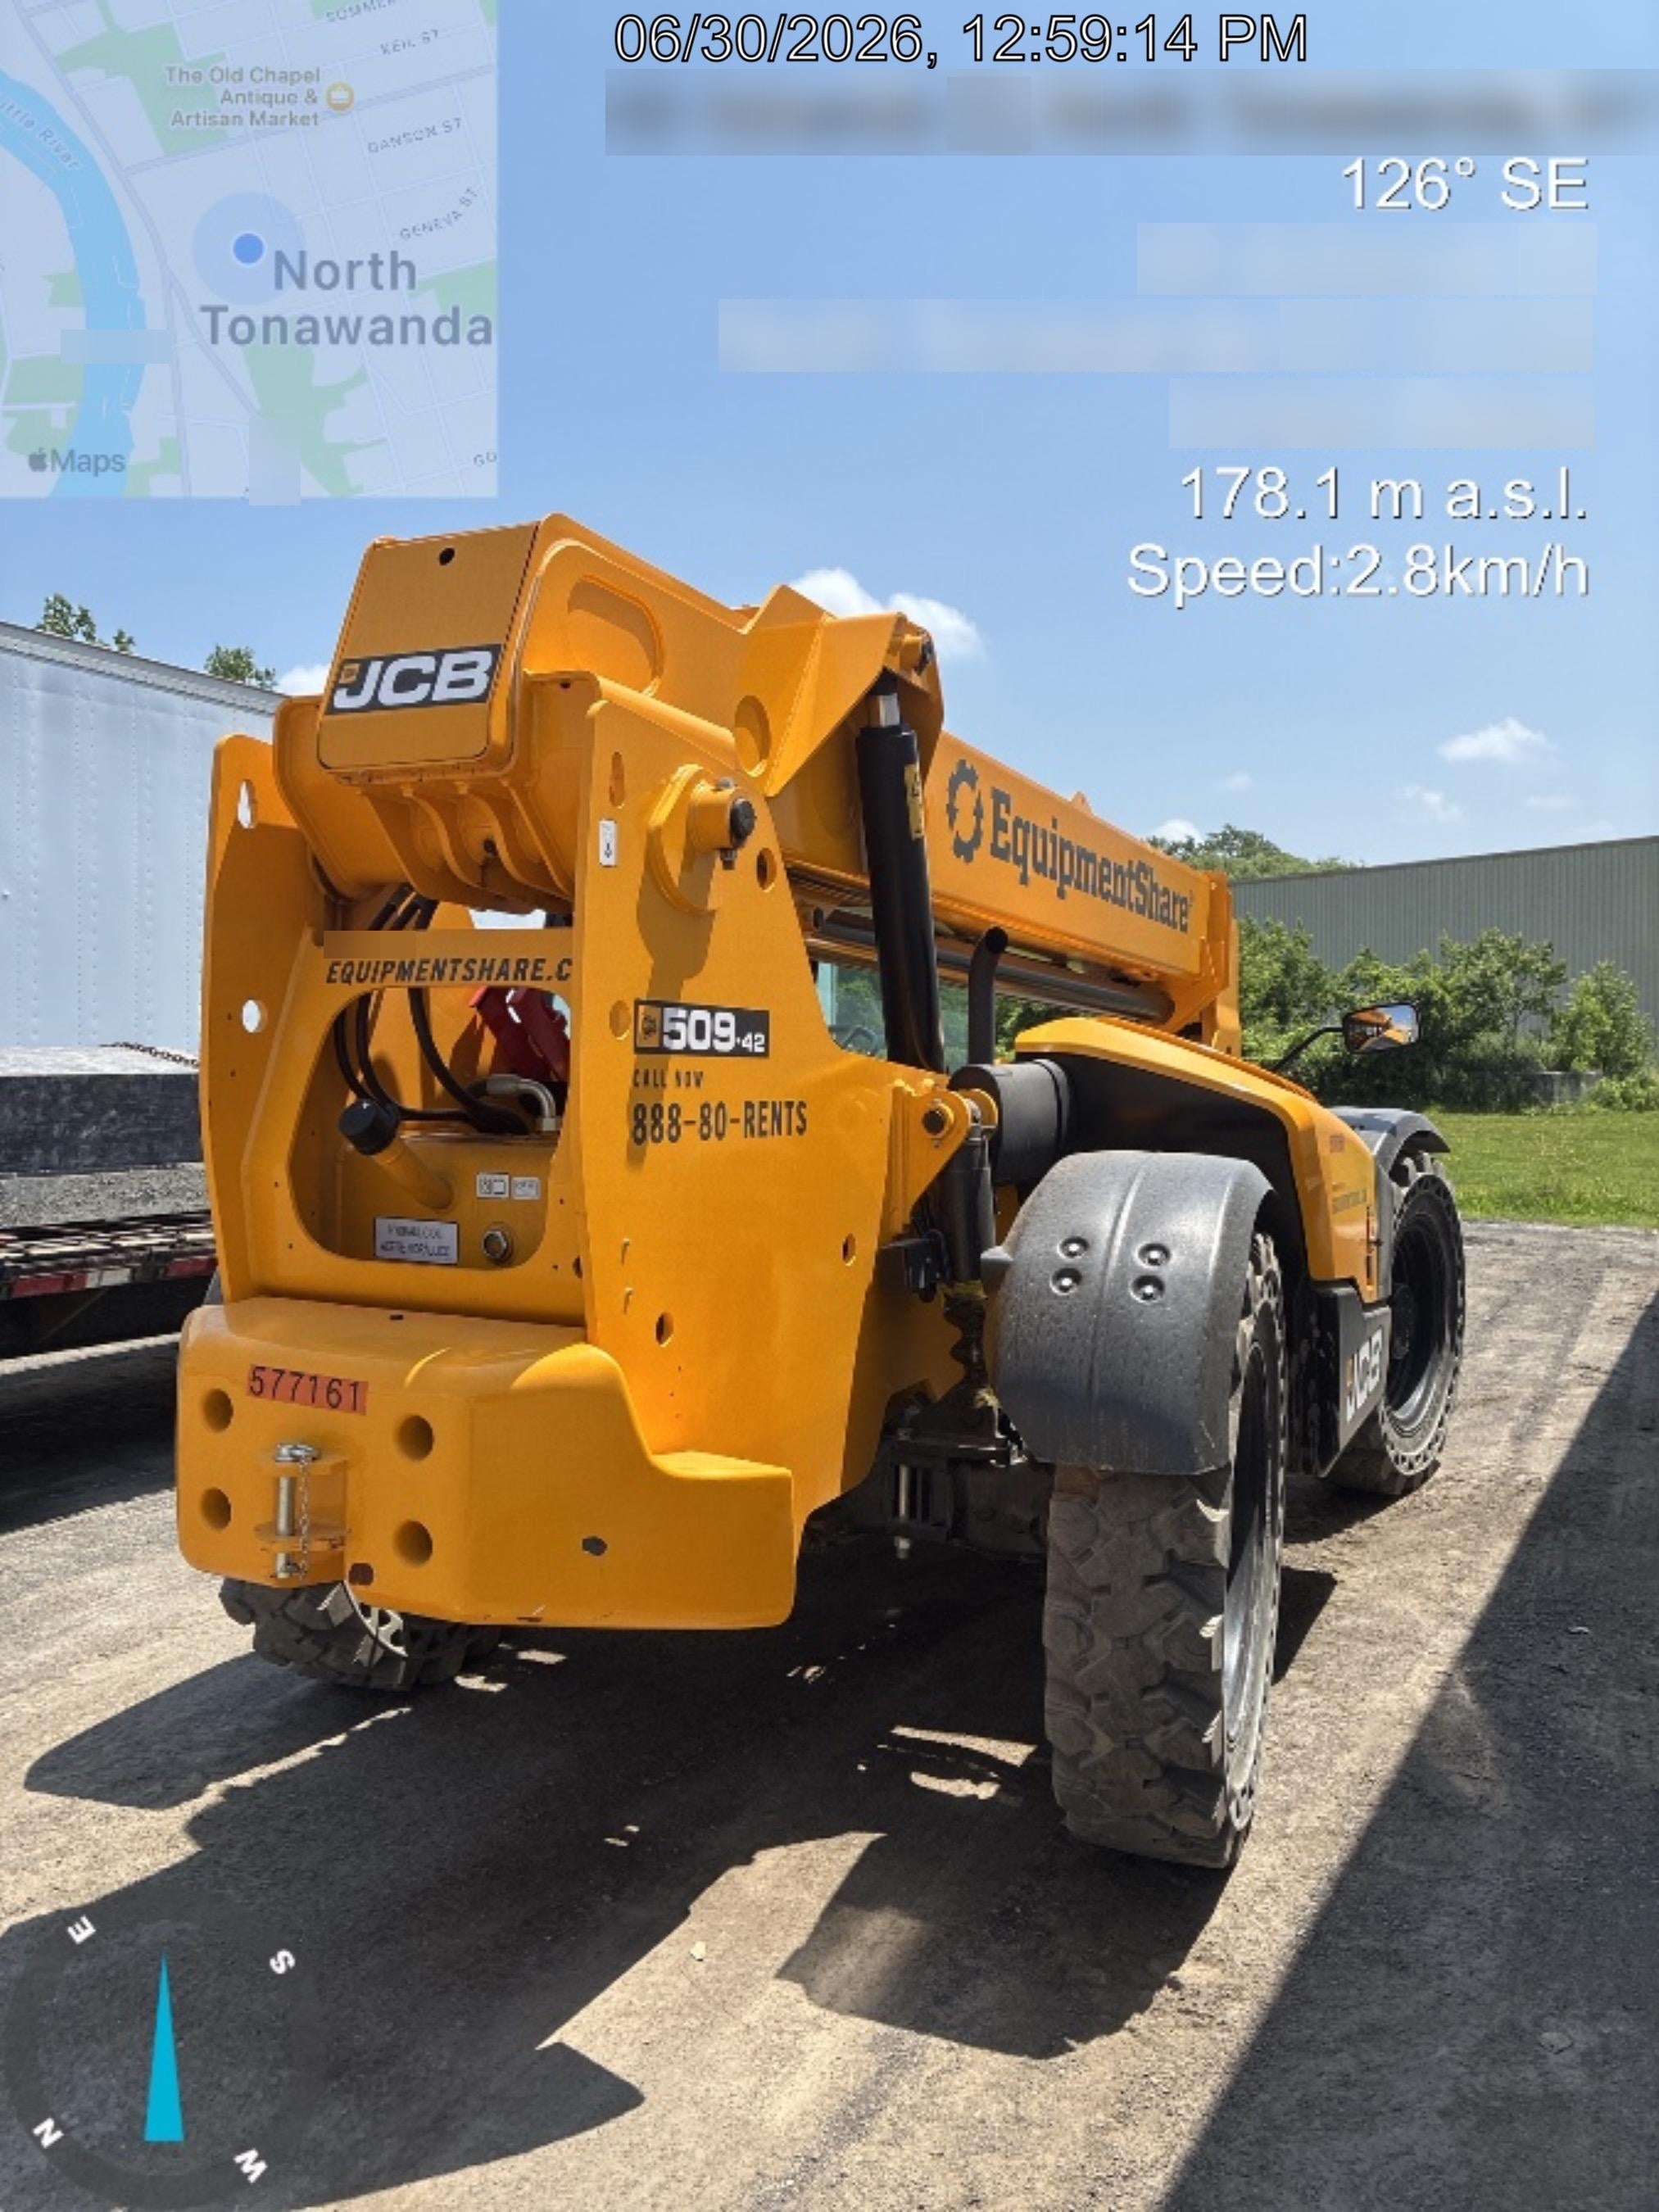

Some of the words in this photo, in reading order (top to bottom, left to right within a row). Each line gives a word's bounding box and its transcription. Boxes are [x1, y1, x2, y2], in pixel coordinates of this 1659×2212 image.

[333, 650, 492, 709] JCB
[990, 786, 1188, 932] EquipmentShare
[326, 958, 572, 985] EQUIPMENTSHARE.C
[634, 1069, 666, 1087] CALL
[632, 1100, 807, 1145] 888-80-RENTS
[250, 1366, 359, 1412] 577161
[1346, 1328, 1382, 1422] JCB
